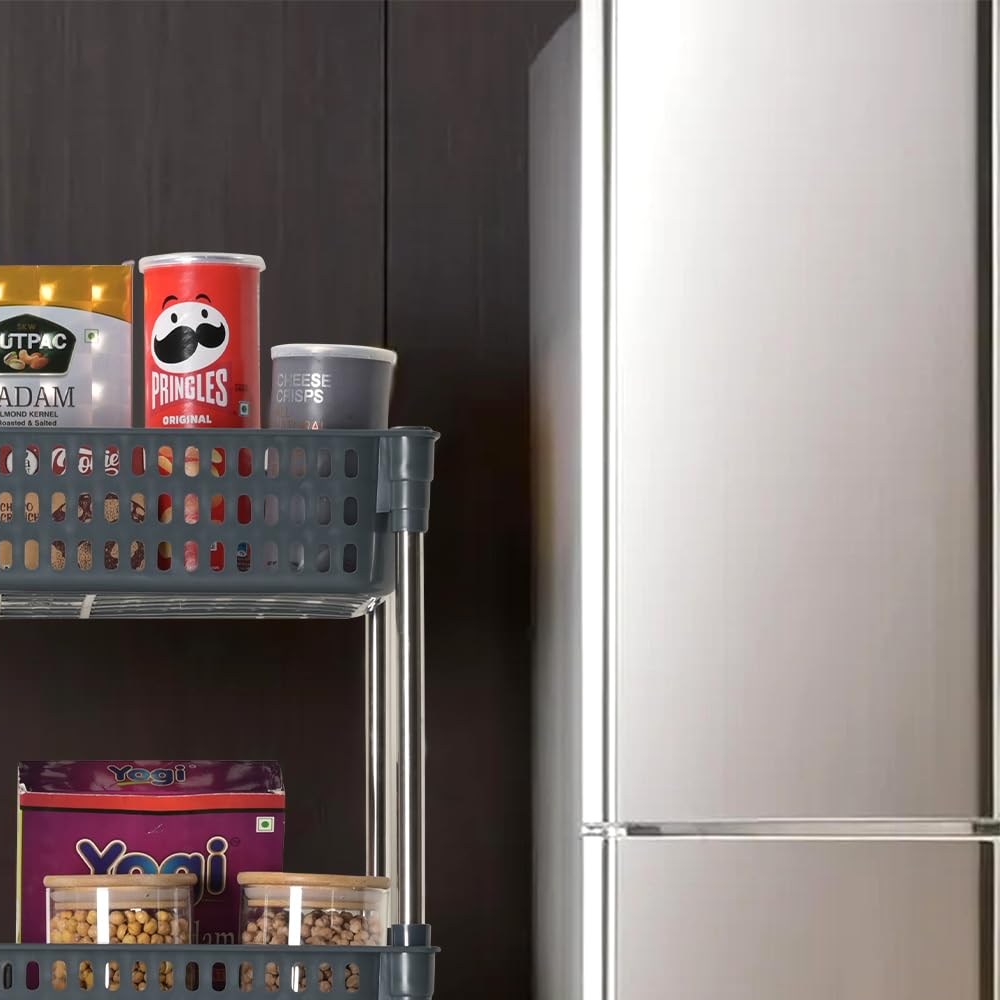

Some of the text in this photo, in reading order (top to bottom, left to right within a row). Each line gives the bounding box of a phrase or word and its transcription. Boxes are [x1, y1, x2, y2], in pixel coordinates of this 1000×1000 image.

[278, 373, 331, 388] CHEESE
[151, 368, 228, 410] PRINGLES
[277, 389, 325, 404] CRISPS
[162, 414, 213, 425] ORIGINAL
[107, 764, 186, 786] Yogi
